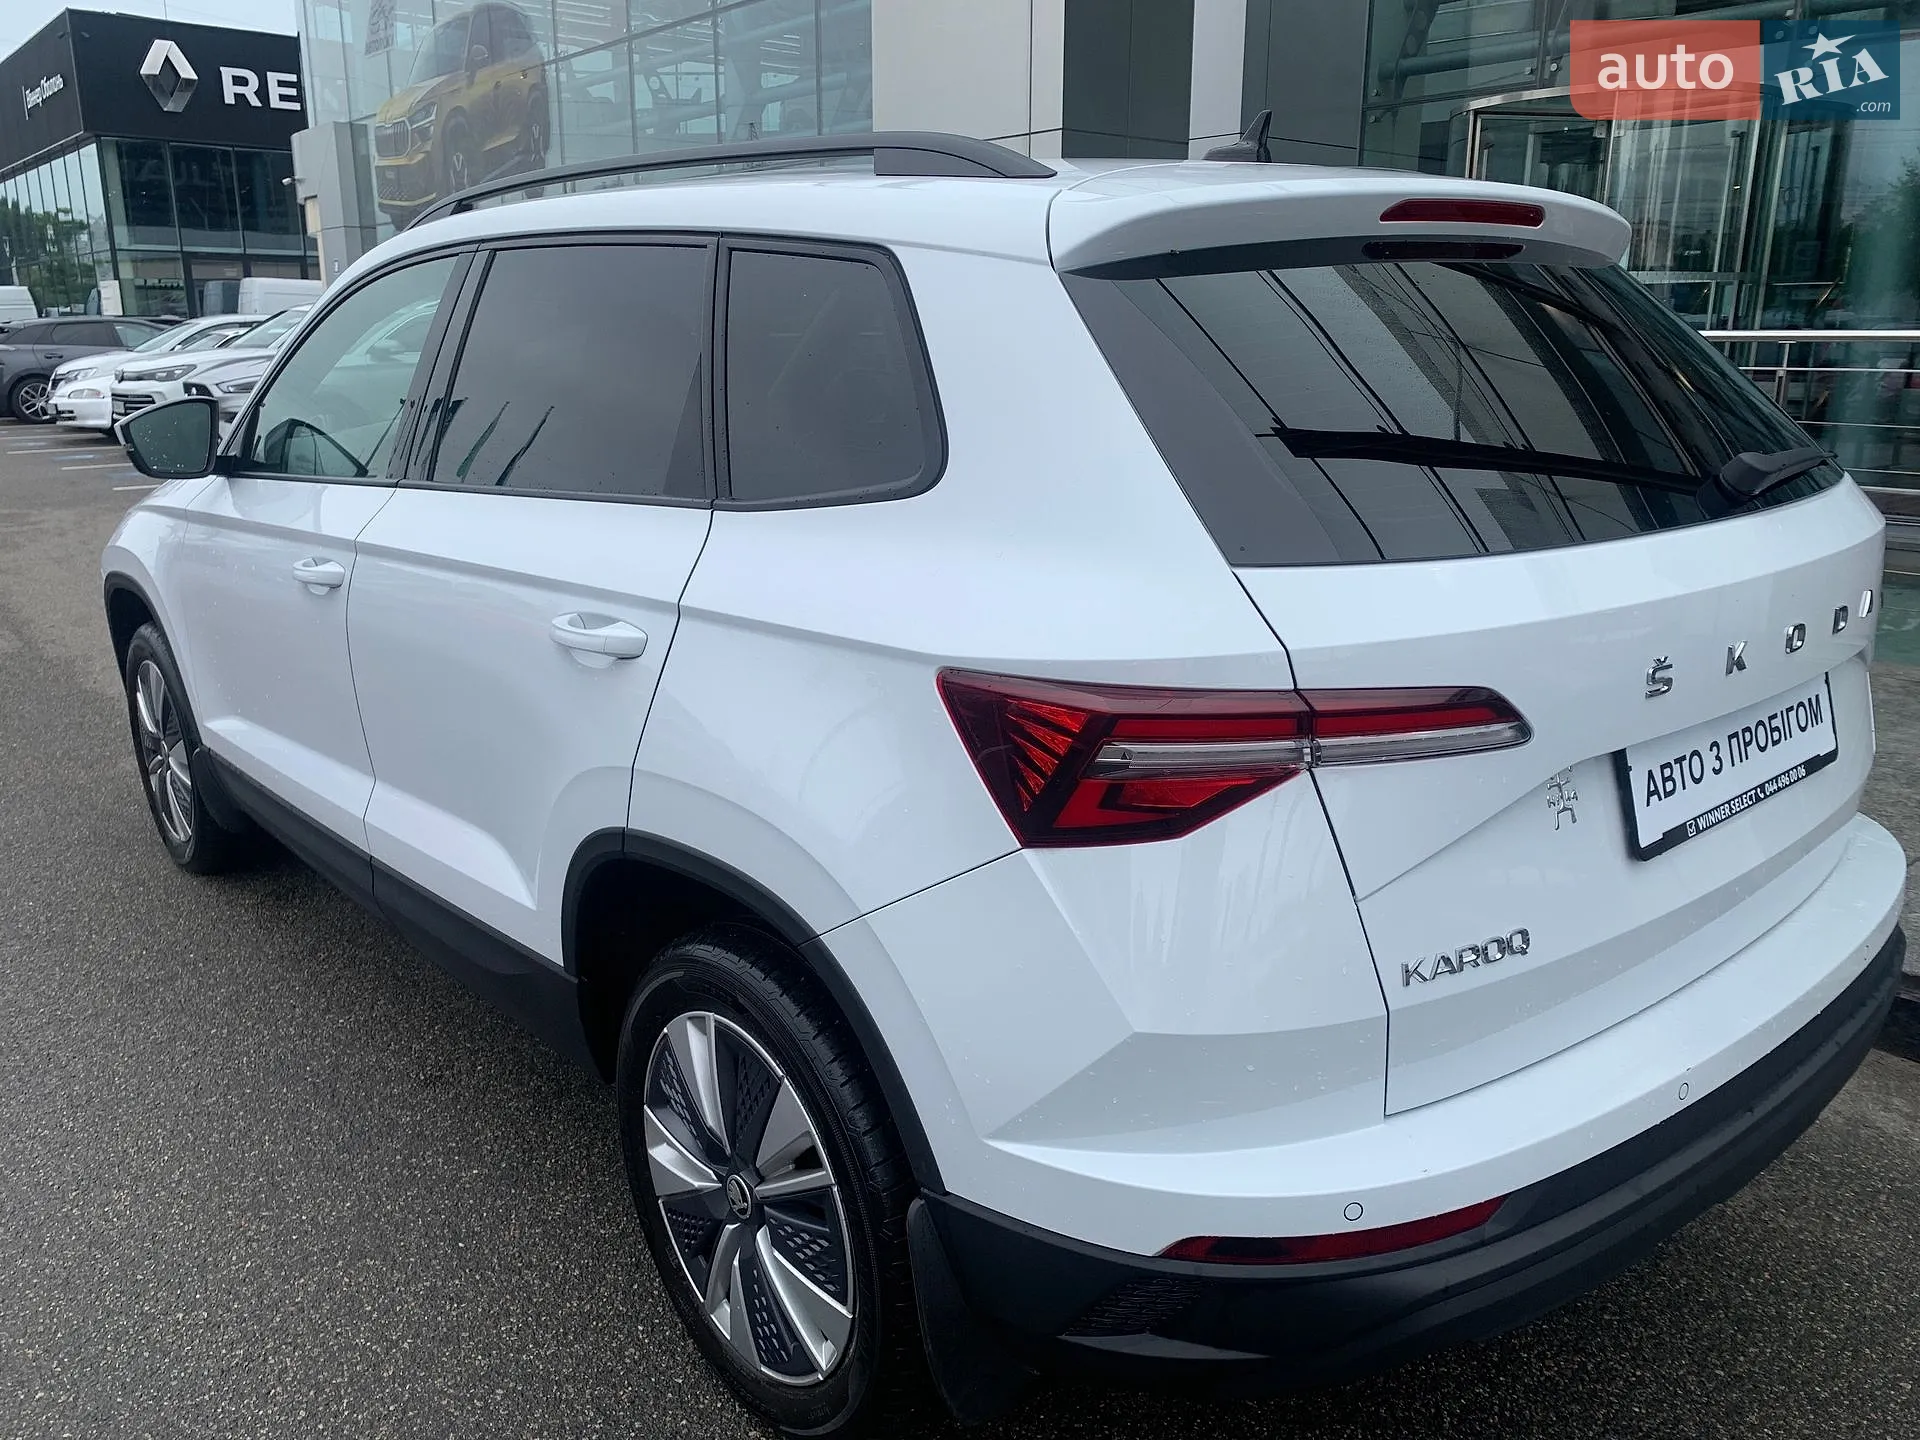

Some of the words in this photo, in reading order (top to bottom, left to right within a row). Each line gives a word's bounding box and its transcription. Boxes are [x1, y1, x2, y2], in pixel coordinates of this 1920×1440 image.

[1646, 749, 1704, 806] АВТО
[1727, 693, 1823, 767] ПРОБІГОМ
[1696, 804, 1731, 831] WINNER
[1730, 789, 1757, 814] SELECT
[1400, 927, 1531, 988] KAROQ
